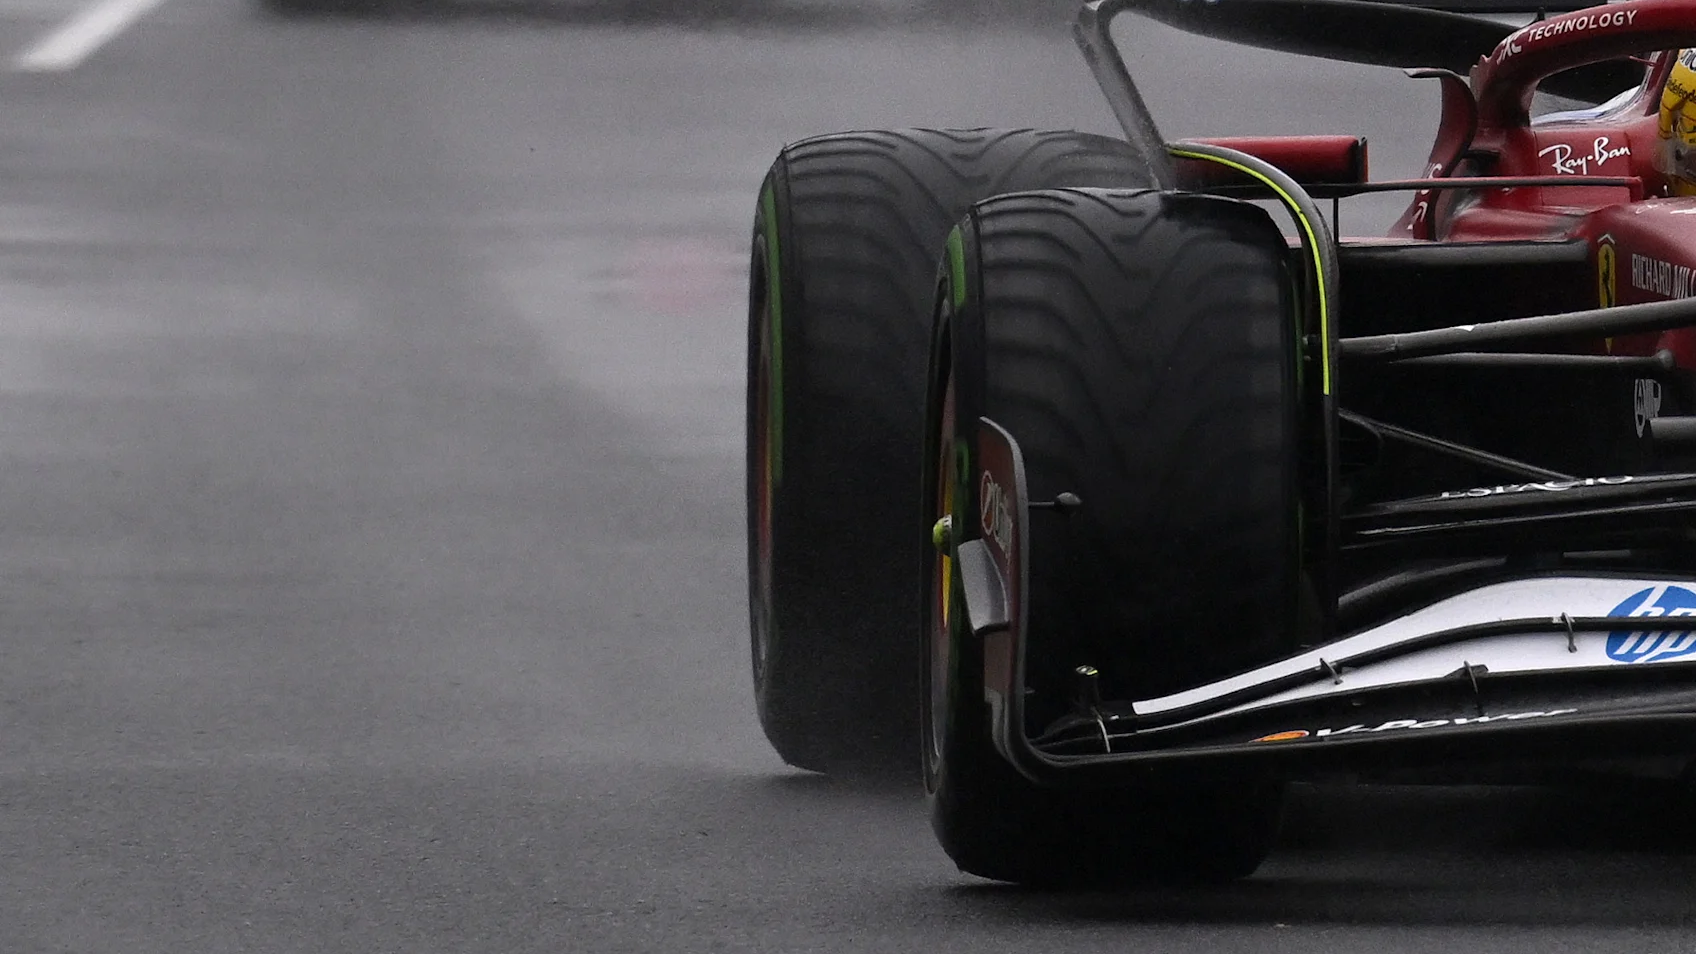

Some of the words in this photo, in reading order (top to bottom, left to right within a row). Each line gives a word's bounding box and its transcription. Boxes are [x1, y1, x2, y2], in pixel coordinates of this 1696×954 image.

[1527, 10, 1637, 42] TECHNOLOGY
[1538, 136, 1631, 175] Ray-Ban
[1632, 253, 1671, 296] RICHARD
